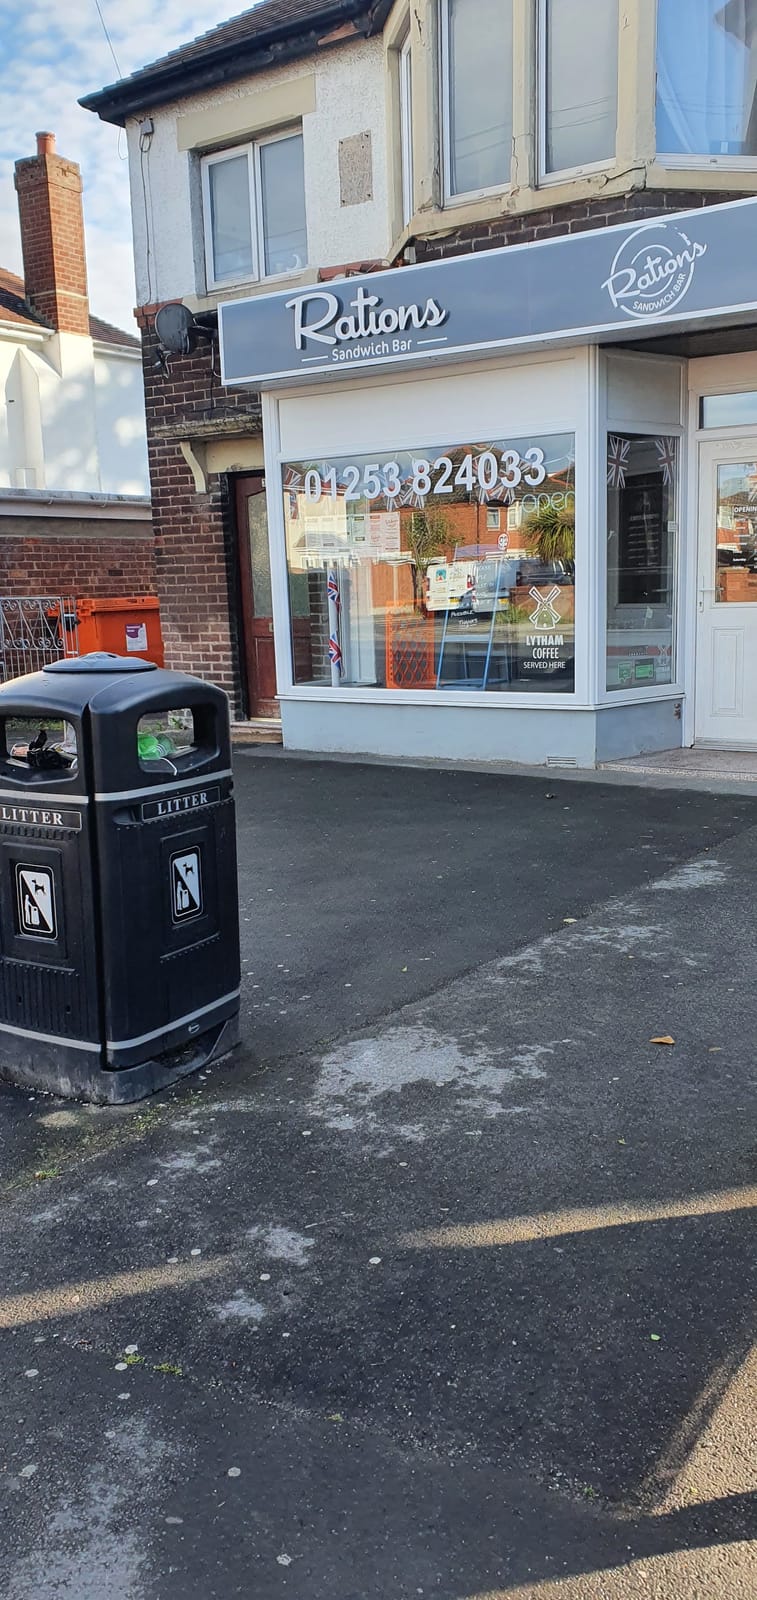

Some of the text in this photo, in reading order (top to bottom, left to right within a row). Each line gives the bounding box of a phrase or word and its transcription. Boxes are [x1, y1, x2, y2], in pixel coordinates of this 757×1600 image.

[600, 242, 707, 308] Rations
[632, 272, 686, 312] SANDWICH BAR
[285, 287, 447, 350] Rations
[331, 338, 412, 361] Sandwich Bar
[305, 448, 546, 503] 01253 824033
[526, 634, 564, 646] LYTHAM
[532, 647, 560, 659] COFFEE
[523, 661, 566, 669] SERVED HERE
[157, 792, 208, 816] LITTER
[1, 807, 64, 826] LITTER
